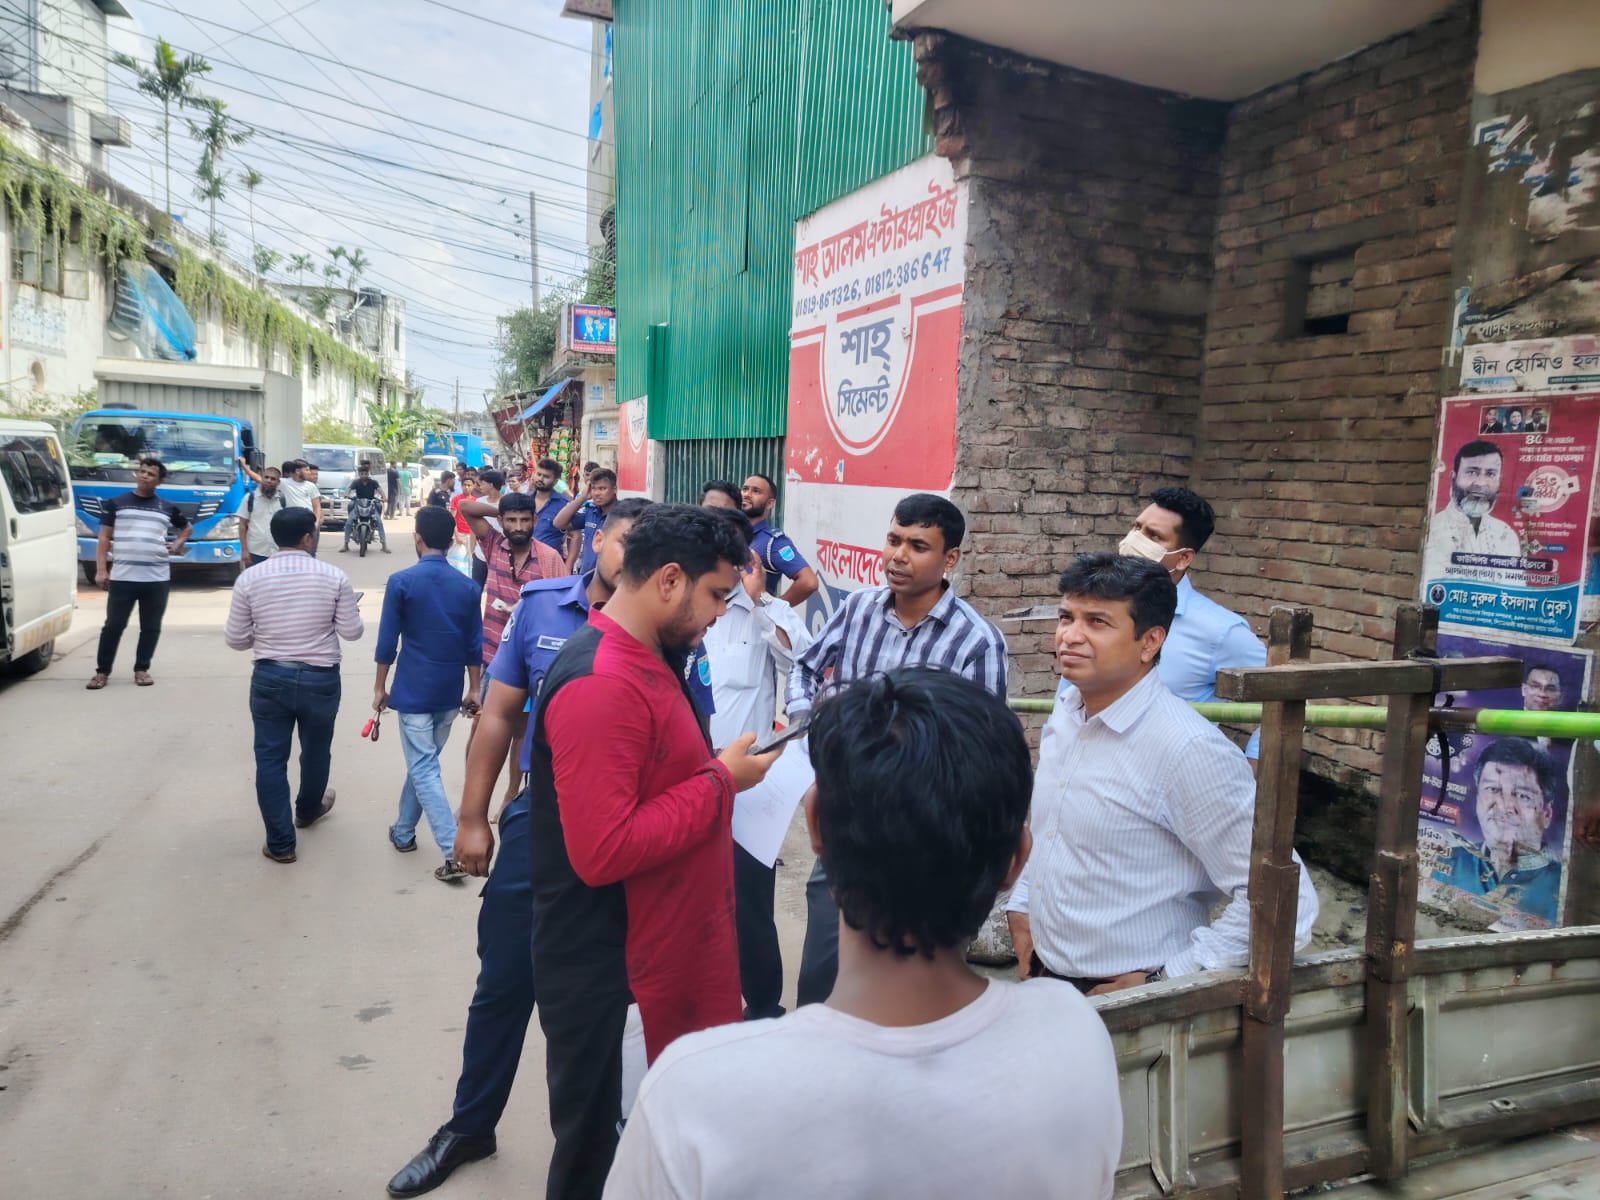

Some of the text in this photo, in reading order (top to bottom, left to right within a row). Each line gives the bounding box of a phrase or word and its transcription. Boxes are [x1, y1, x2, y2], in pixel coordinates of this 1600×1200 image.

[821, 221, 868, 278] আলম
[1505, 352, 1563, 374] হোমিও
[837, 374, 890, 417] সিমেন্ট
[1449, 589, 1468, 604] মোঃ
[1471, 591, 1498, 609] নুরুল
[1500, 590, 1538, 612] ইসলাম
